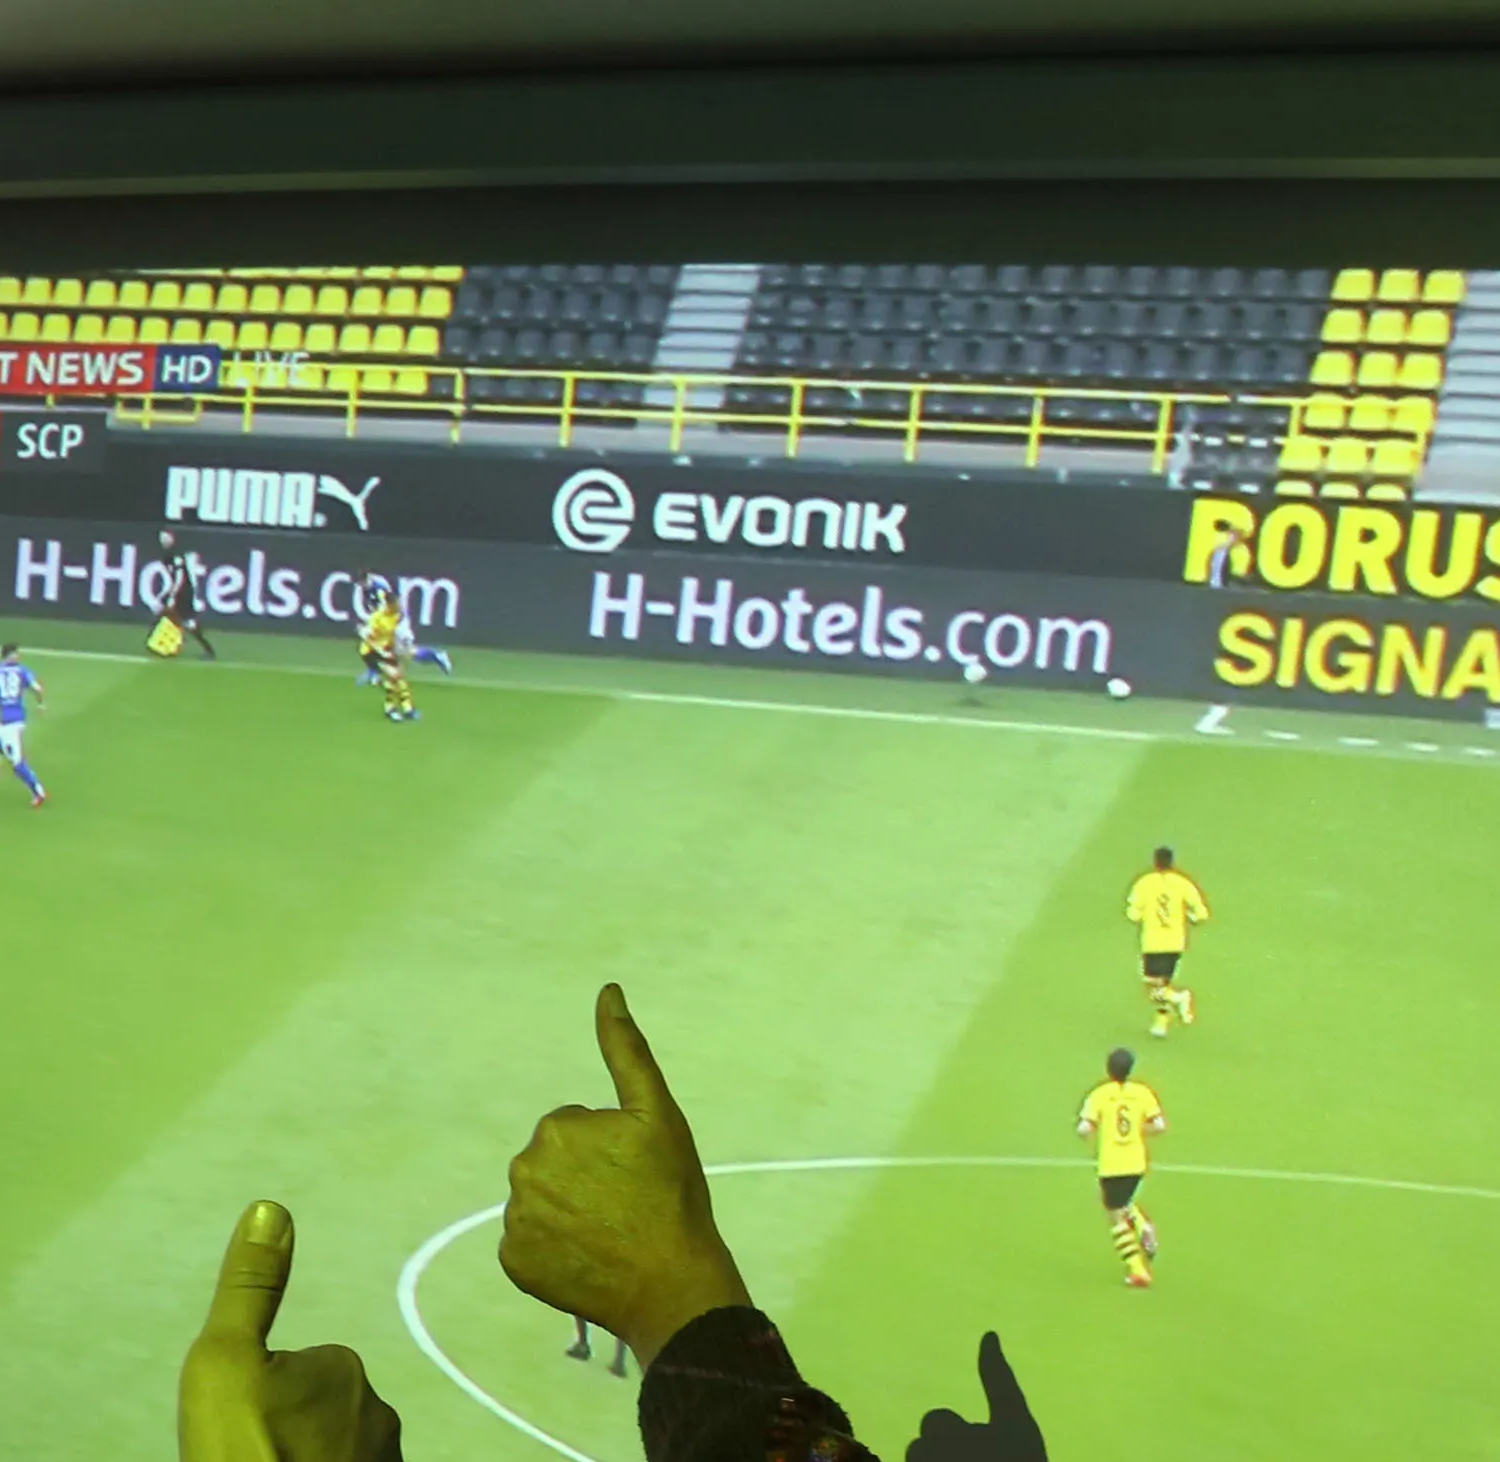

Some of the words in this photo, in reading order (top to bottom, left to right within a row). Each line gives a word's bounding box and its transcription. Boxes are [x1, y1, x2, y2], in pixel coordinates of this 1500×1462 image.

[27, 352, 143, 386] NEWS
[162, 354, 213, 384] HD
[17, 424, 83, 459] SCP
[165, 466, 316, 528] PUMA
[652, 493, 907, 553] EVONIK
[588, 571, 1113, 674] H-Hotels.com
[1116, 1104, 1131, 1137] 6
